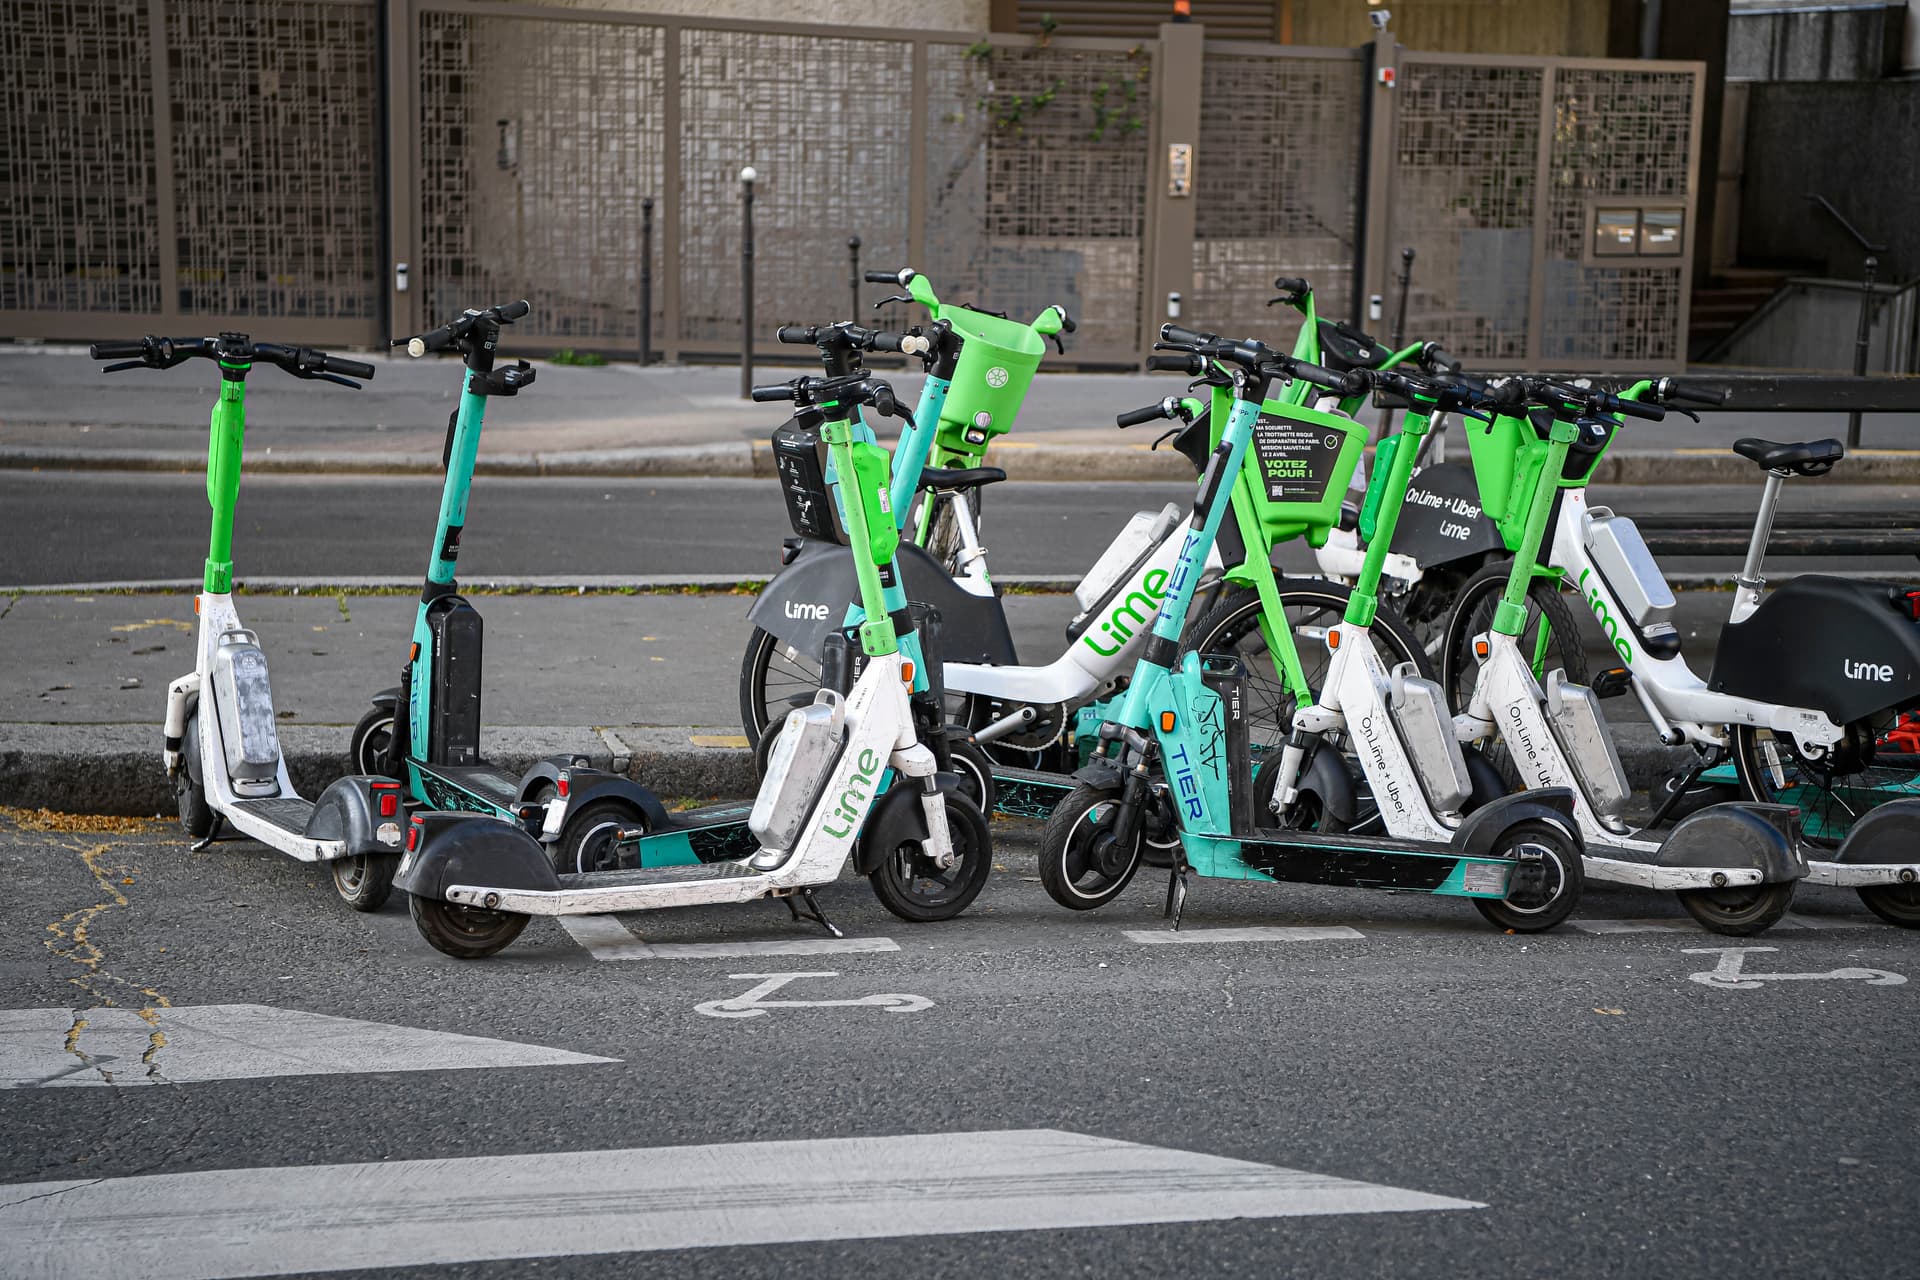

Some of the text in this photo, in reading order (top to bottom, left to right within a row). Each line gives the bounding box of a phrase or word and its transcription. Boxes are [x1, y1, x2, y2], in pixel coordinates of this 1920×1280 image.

[1264, 460, 1308, 469] VOTEZ
[1268, 469, 1306, 478] POUR
[1451, 498, 1481, 519] Uber
[1440, 519, 1471, 540] Lime
[1156, 534, 1200, 624] TIER
[784, 600, 830, 620] Lime
[1083, 568, 1170, 657] Lime
[1579, 567, 1633, 665] Lime
[1844, 659, 1894, 682] Lime
[1231, 686, 1241, 721] TIER
[822, 748, 880, 839] Lime
[1172, 743, 1203, 821] TIER
[1387, 781, 1406, 813] Uber
